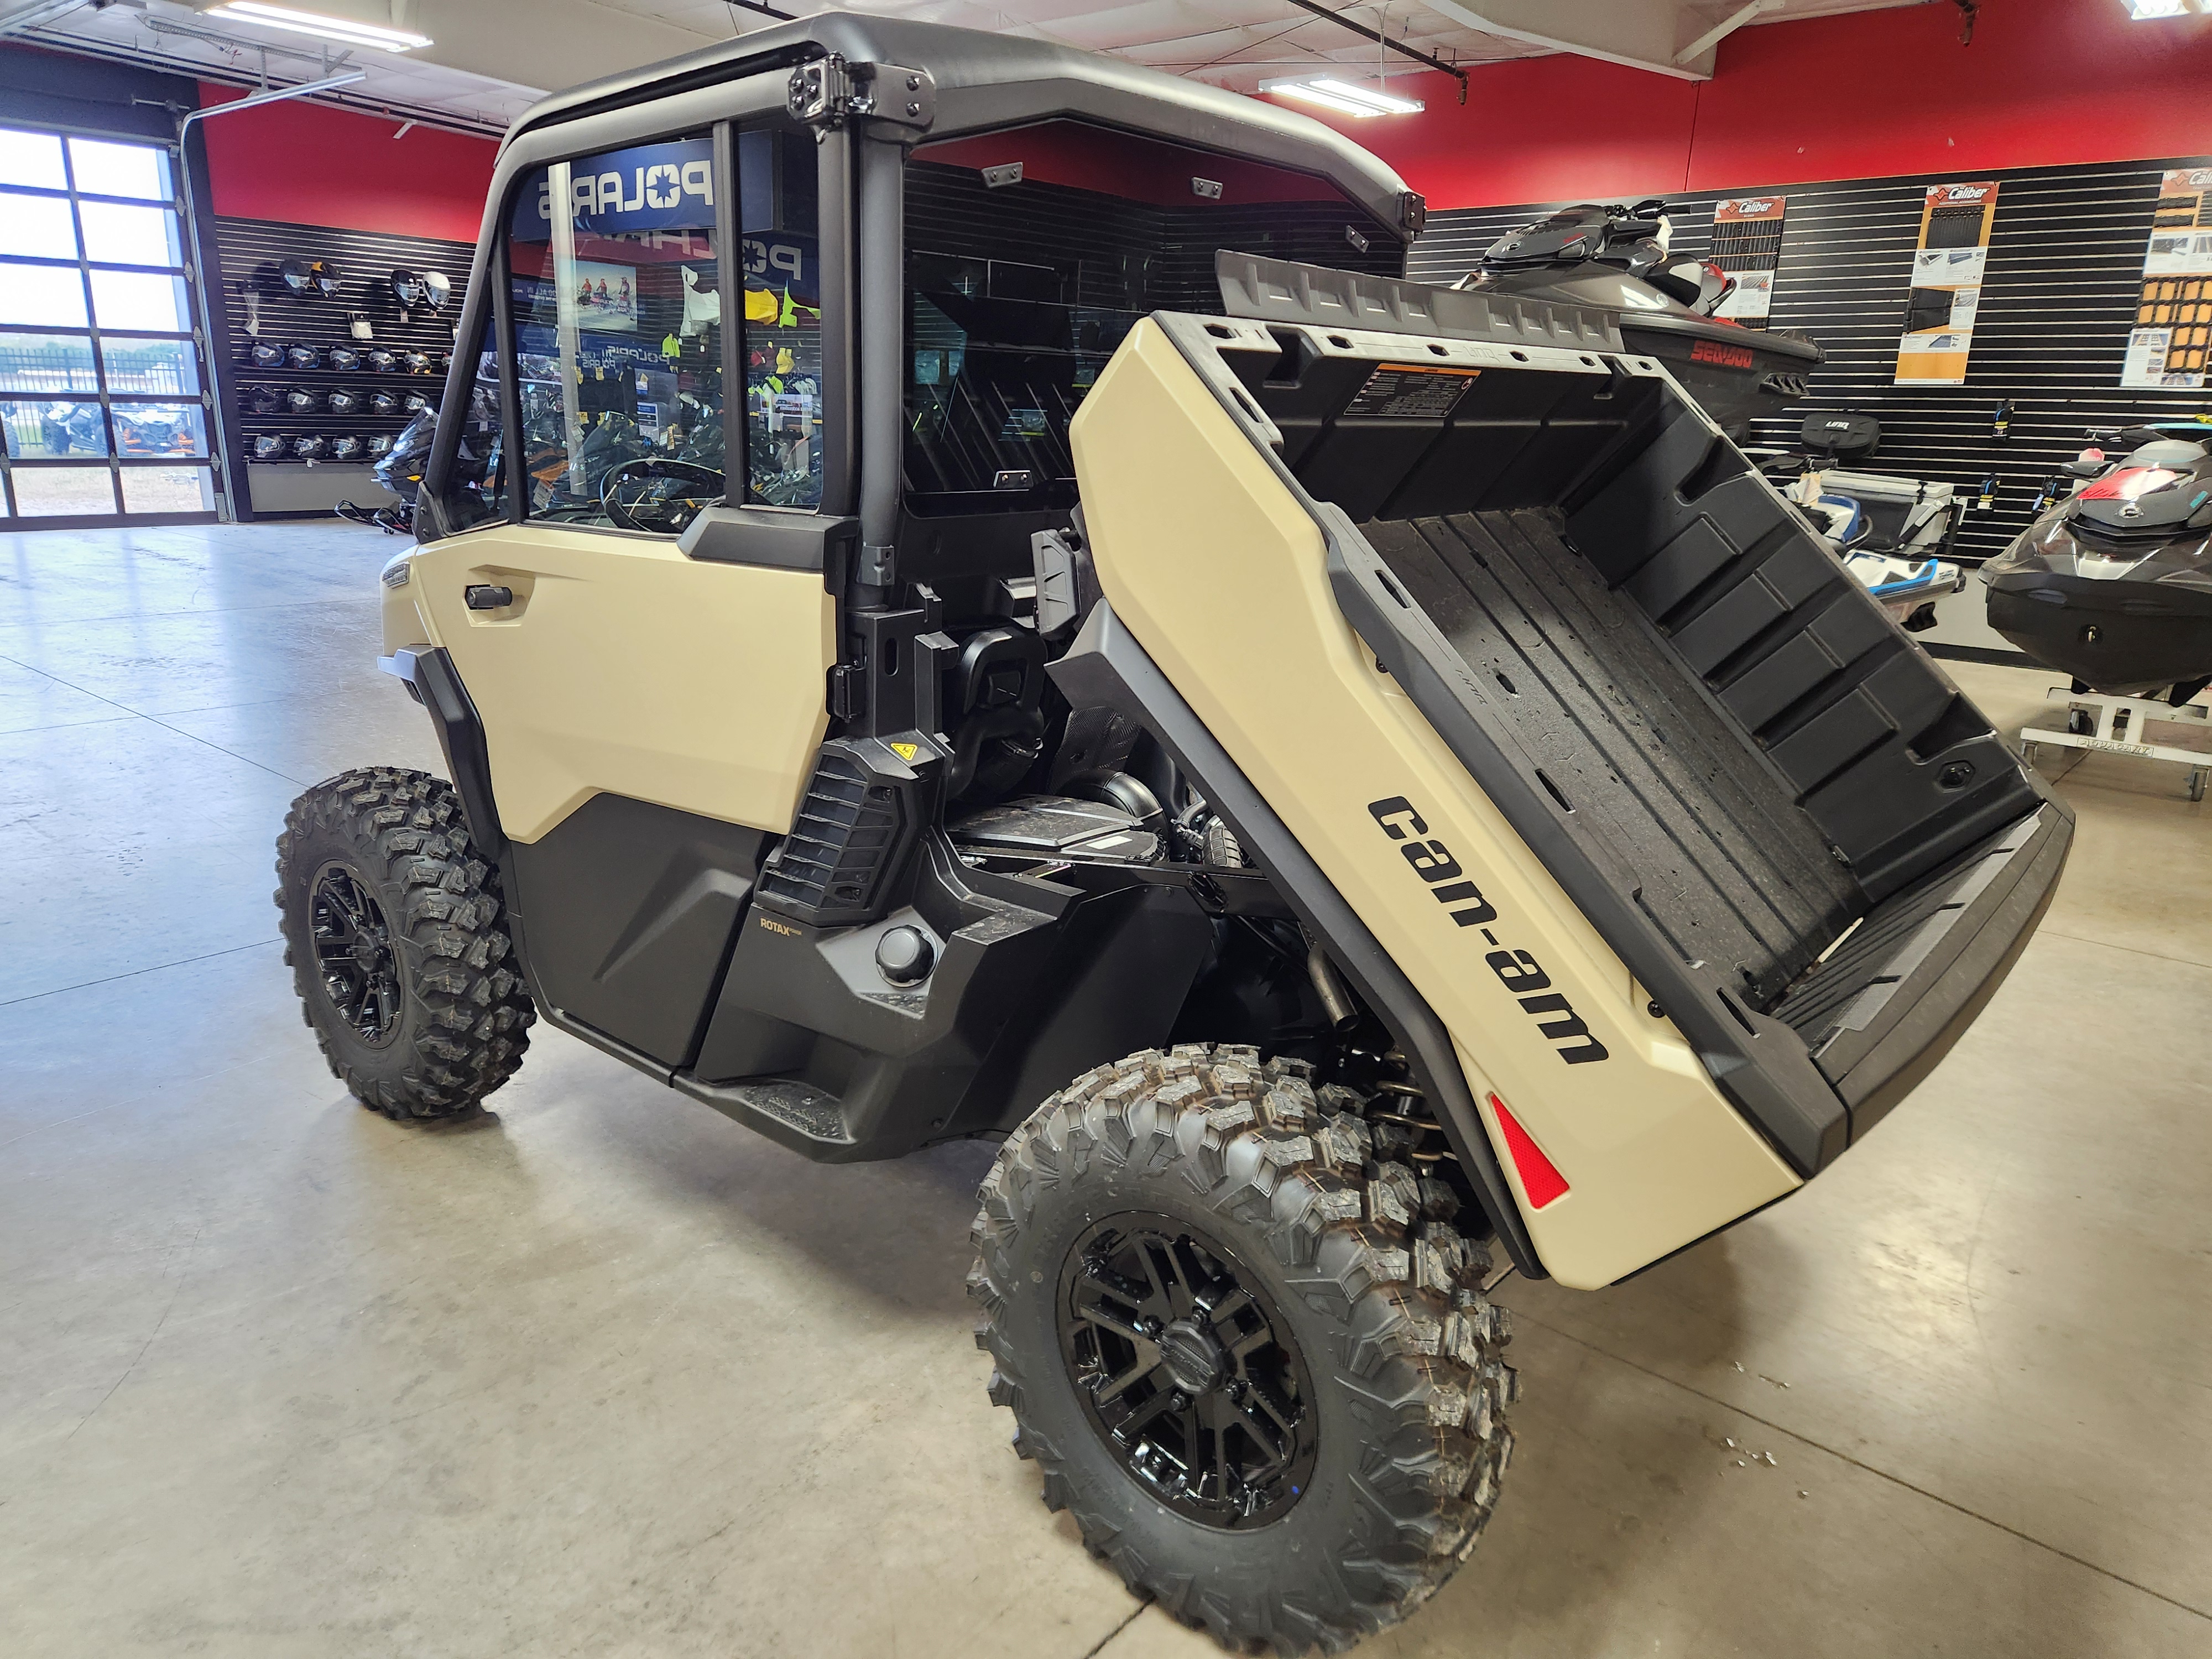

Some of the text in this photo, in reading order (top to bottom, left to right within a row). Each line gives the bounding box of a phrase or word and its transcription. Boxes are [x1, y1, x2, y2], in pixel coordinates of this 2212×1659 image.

[1948, 186, 1990, 200] Caliber
[1738, 201, 1774, 213] Caliber
[760, 917, 790, 936] ROTAX
[1368, 796, 1609, 1065] can-am
